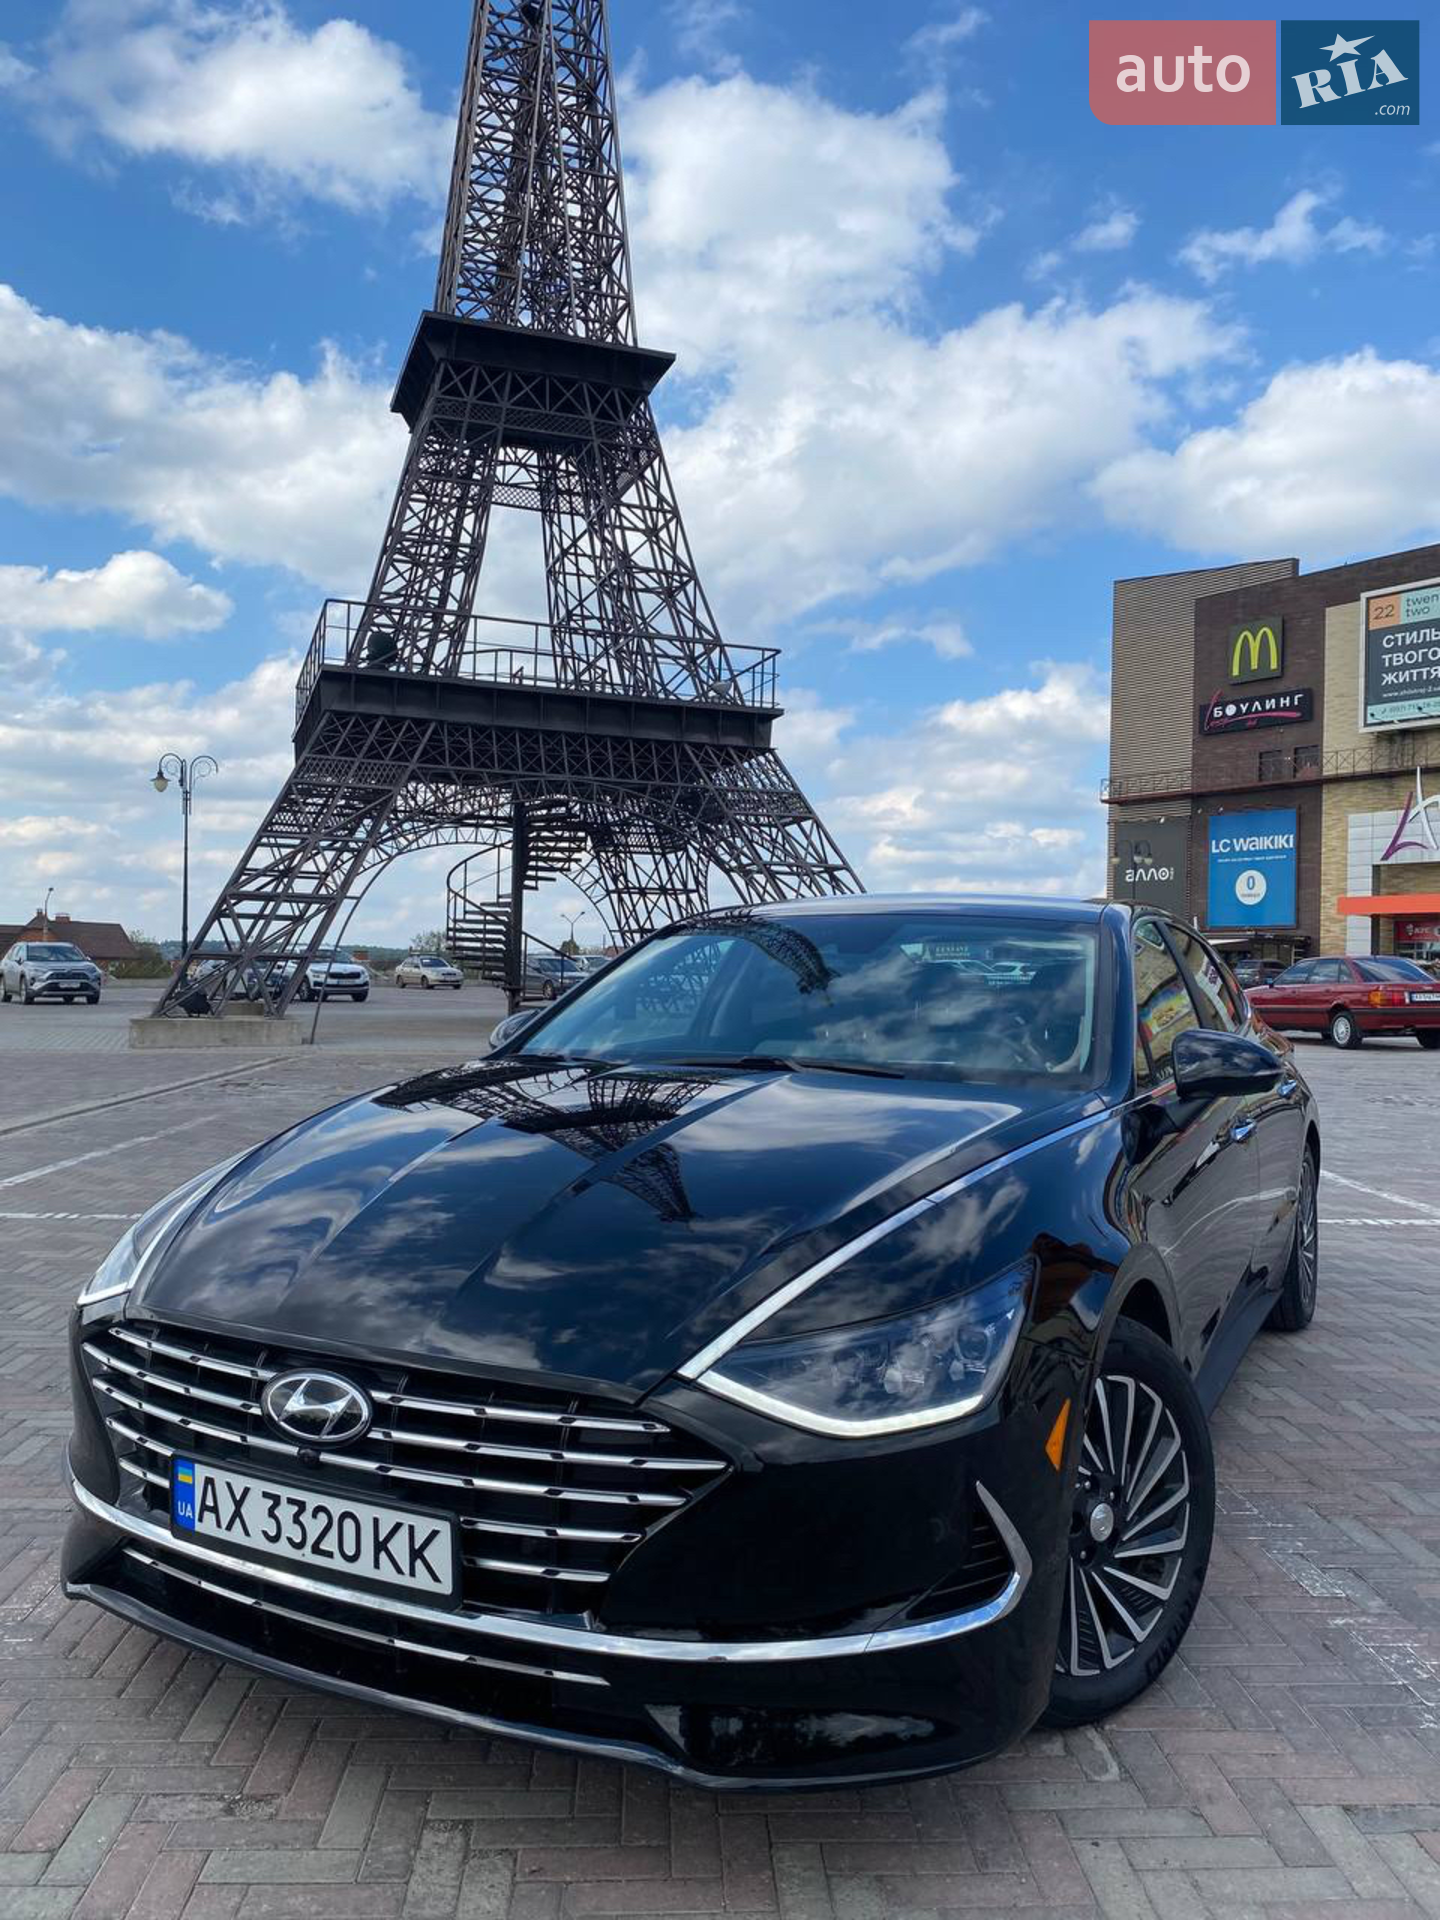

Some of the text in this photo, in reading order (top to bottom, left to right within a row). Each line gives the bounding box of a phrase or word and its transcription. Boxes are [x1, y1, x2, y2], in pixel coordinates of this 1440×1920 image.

[1373, 604, 1395, 620] 22
[1405, 606, 1431, 618] two
[1382, 627, 1440, 649] СТИЛЬ
[1381, 646, 1440, 668] ТВОГО
[1381, 665, 1440, 686] ЖИТТЯ
[1213, 693, 1304, 718] БОУЛИНГ
[1211, 838, 1231, 853] LC
[177, 1500, 194, 1519] UA
[197, 1475, 443, 1584] AX 3320 KK
